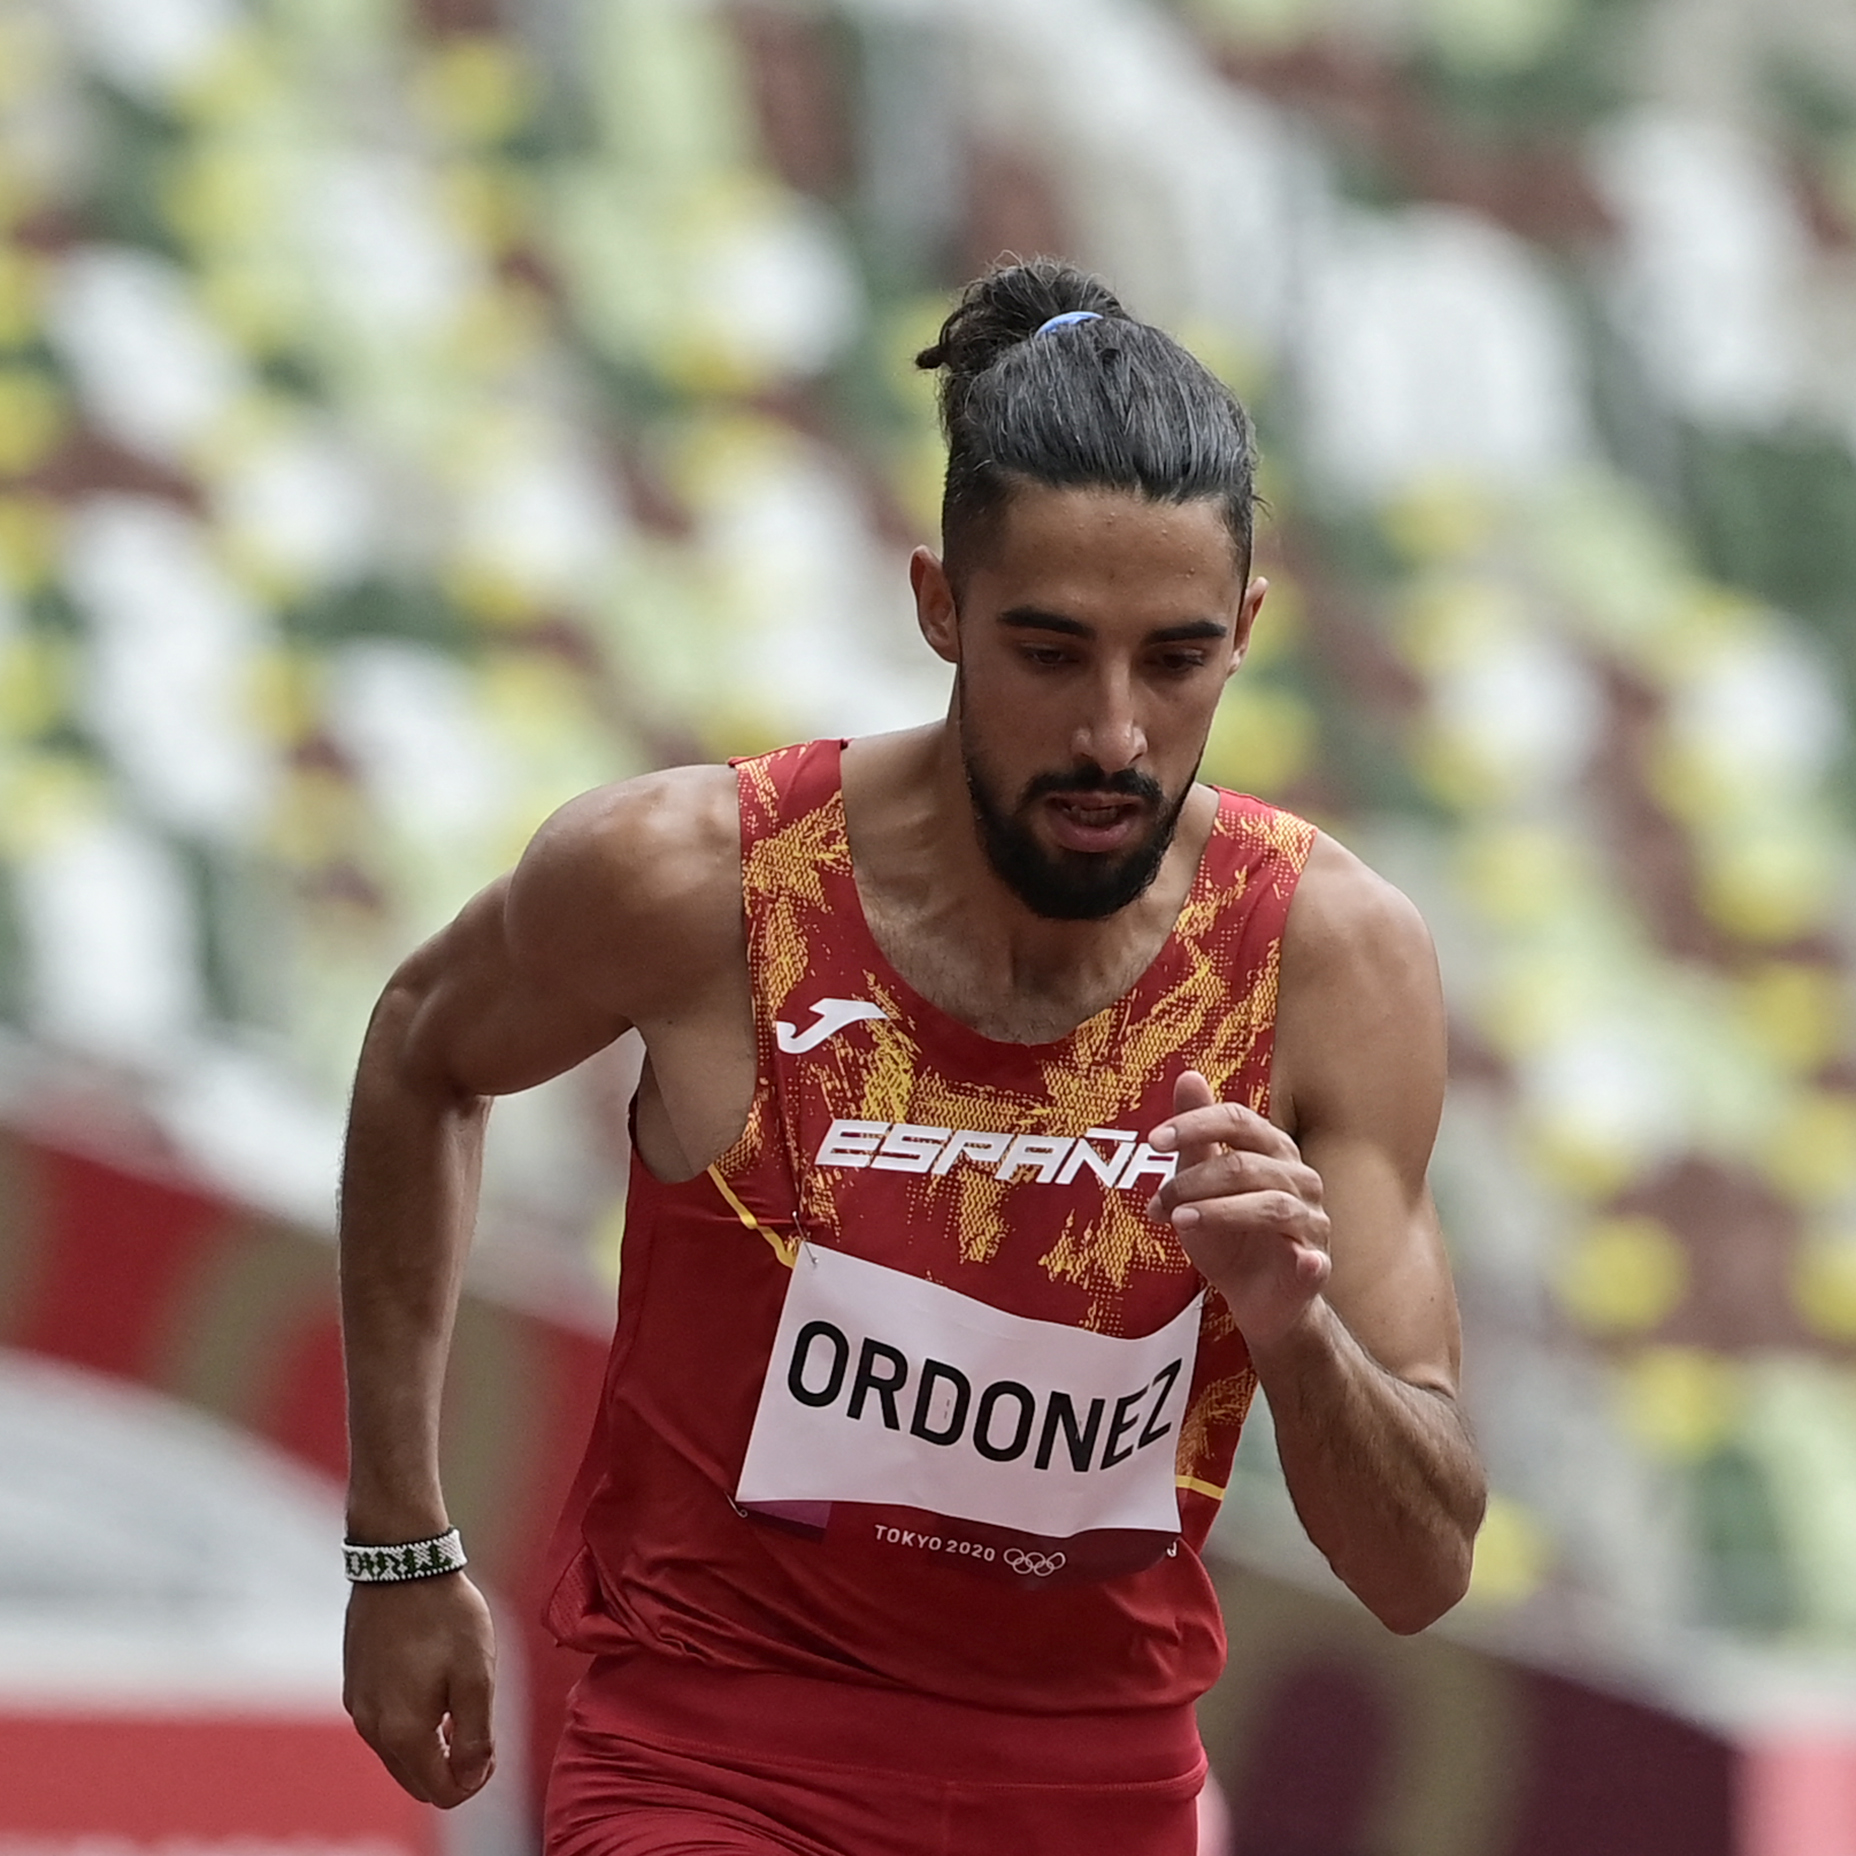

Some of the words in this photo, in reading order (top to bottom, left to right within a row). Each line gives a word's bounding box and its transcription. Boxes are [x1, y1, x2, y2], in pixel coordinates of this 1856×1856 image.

[815, 1119, 1179, 1189] ESPAÑA
[787, 1320, 1182, 1472] ORDONEZ
[875, 1524, 942, 1550] TOKYO
[945, 1540, 995, 1562] 2020
